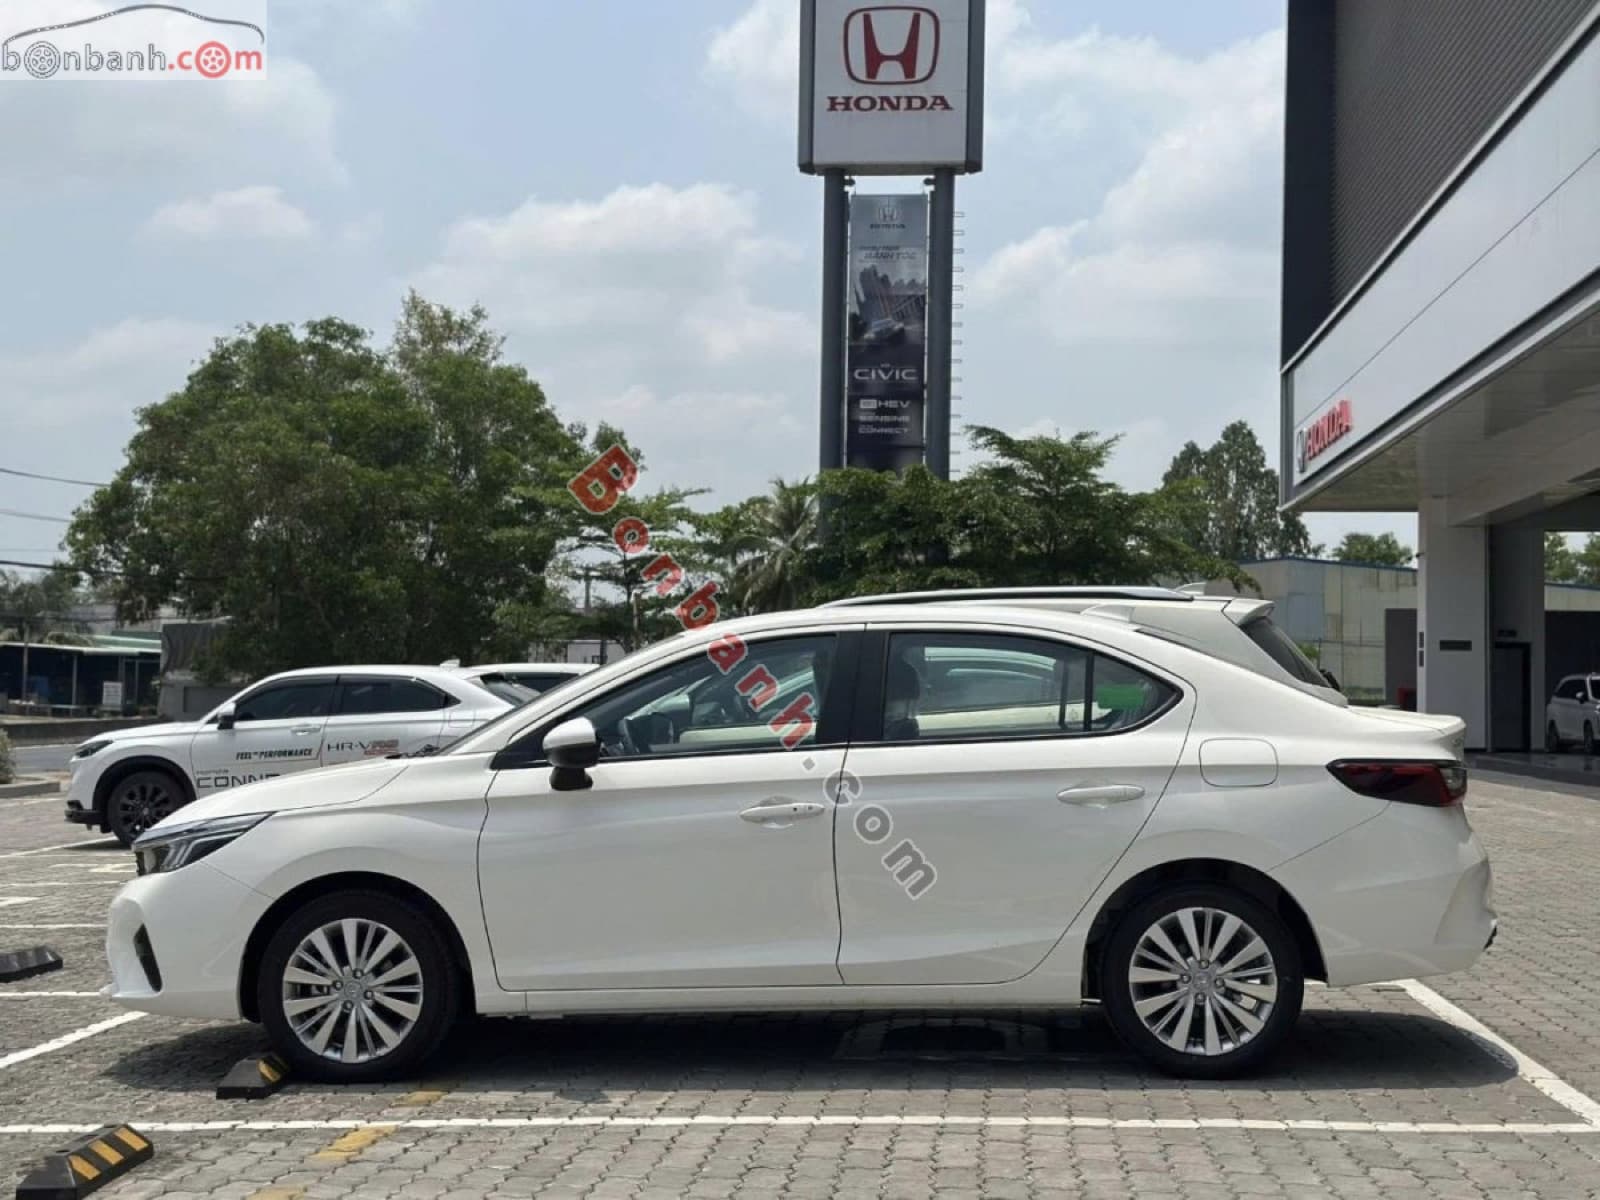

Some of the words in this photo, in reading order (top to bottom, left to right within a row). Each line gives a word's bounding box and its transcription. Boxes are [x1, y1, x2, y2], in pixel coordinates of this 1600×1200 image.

[826, 95, 953, 112] HONDA
[853, 368, 918, 380] CIVIC
[1305, 400, 1351, 461] HONDA
[236, 751, 252, 761] FEEL
[259, 747, 313, 759] PERFORMANCE
